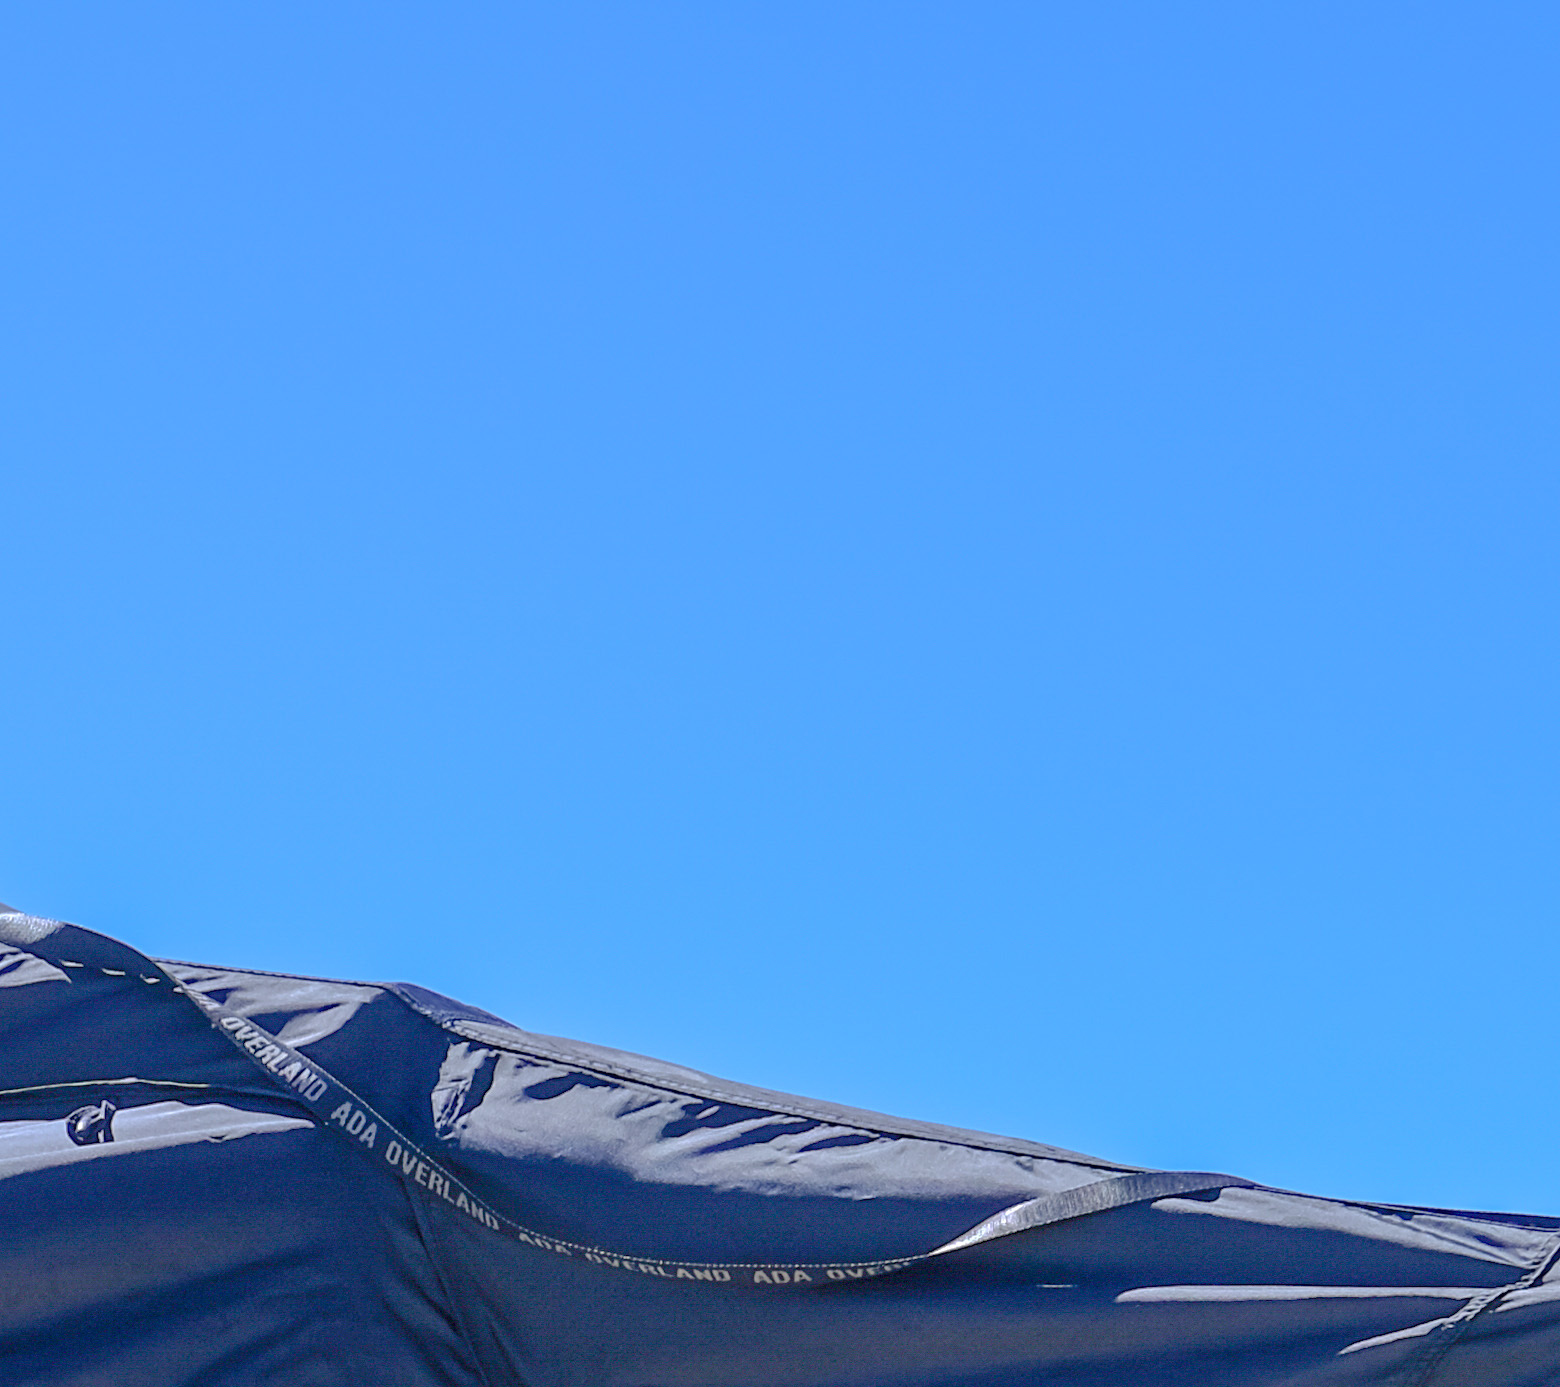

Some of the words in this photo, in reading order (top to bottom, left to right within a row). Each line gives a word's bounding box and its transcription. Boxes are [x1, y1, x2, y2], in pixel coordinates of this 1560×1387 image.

[220, 1016, 328, 1101] OVERLAND
[331, 1101, 378, 1149] ADA
[385, 1140, 500, 1231] OVERLAND
[753, 1269, 812, 1284] ADA
